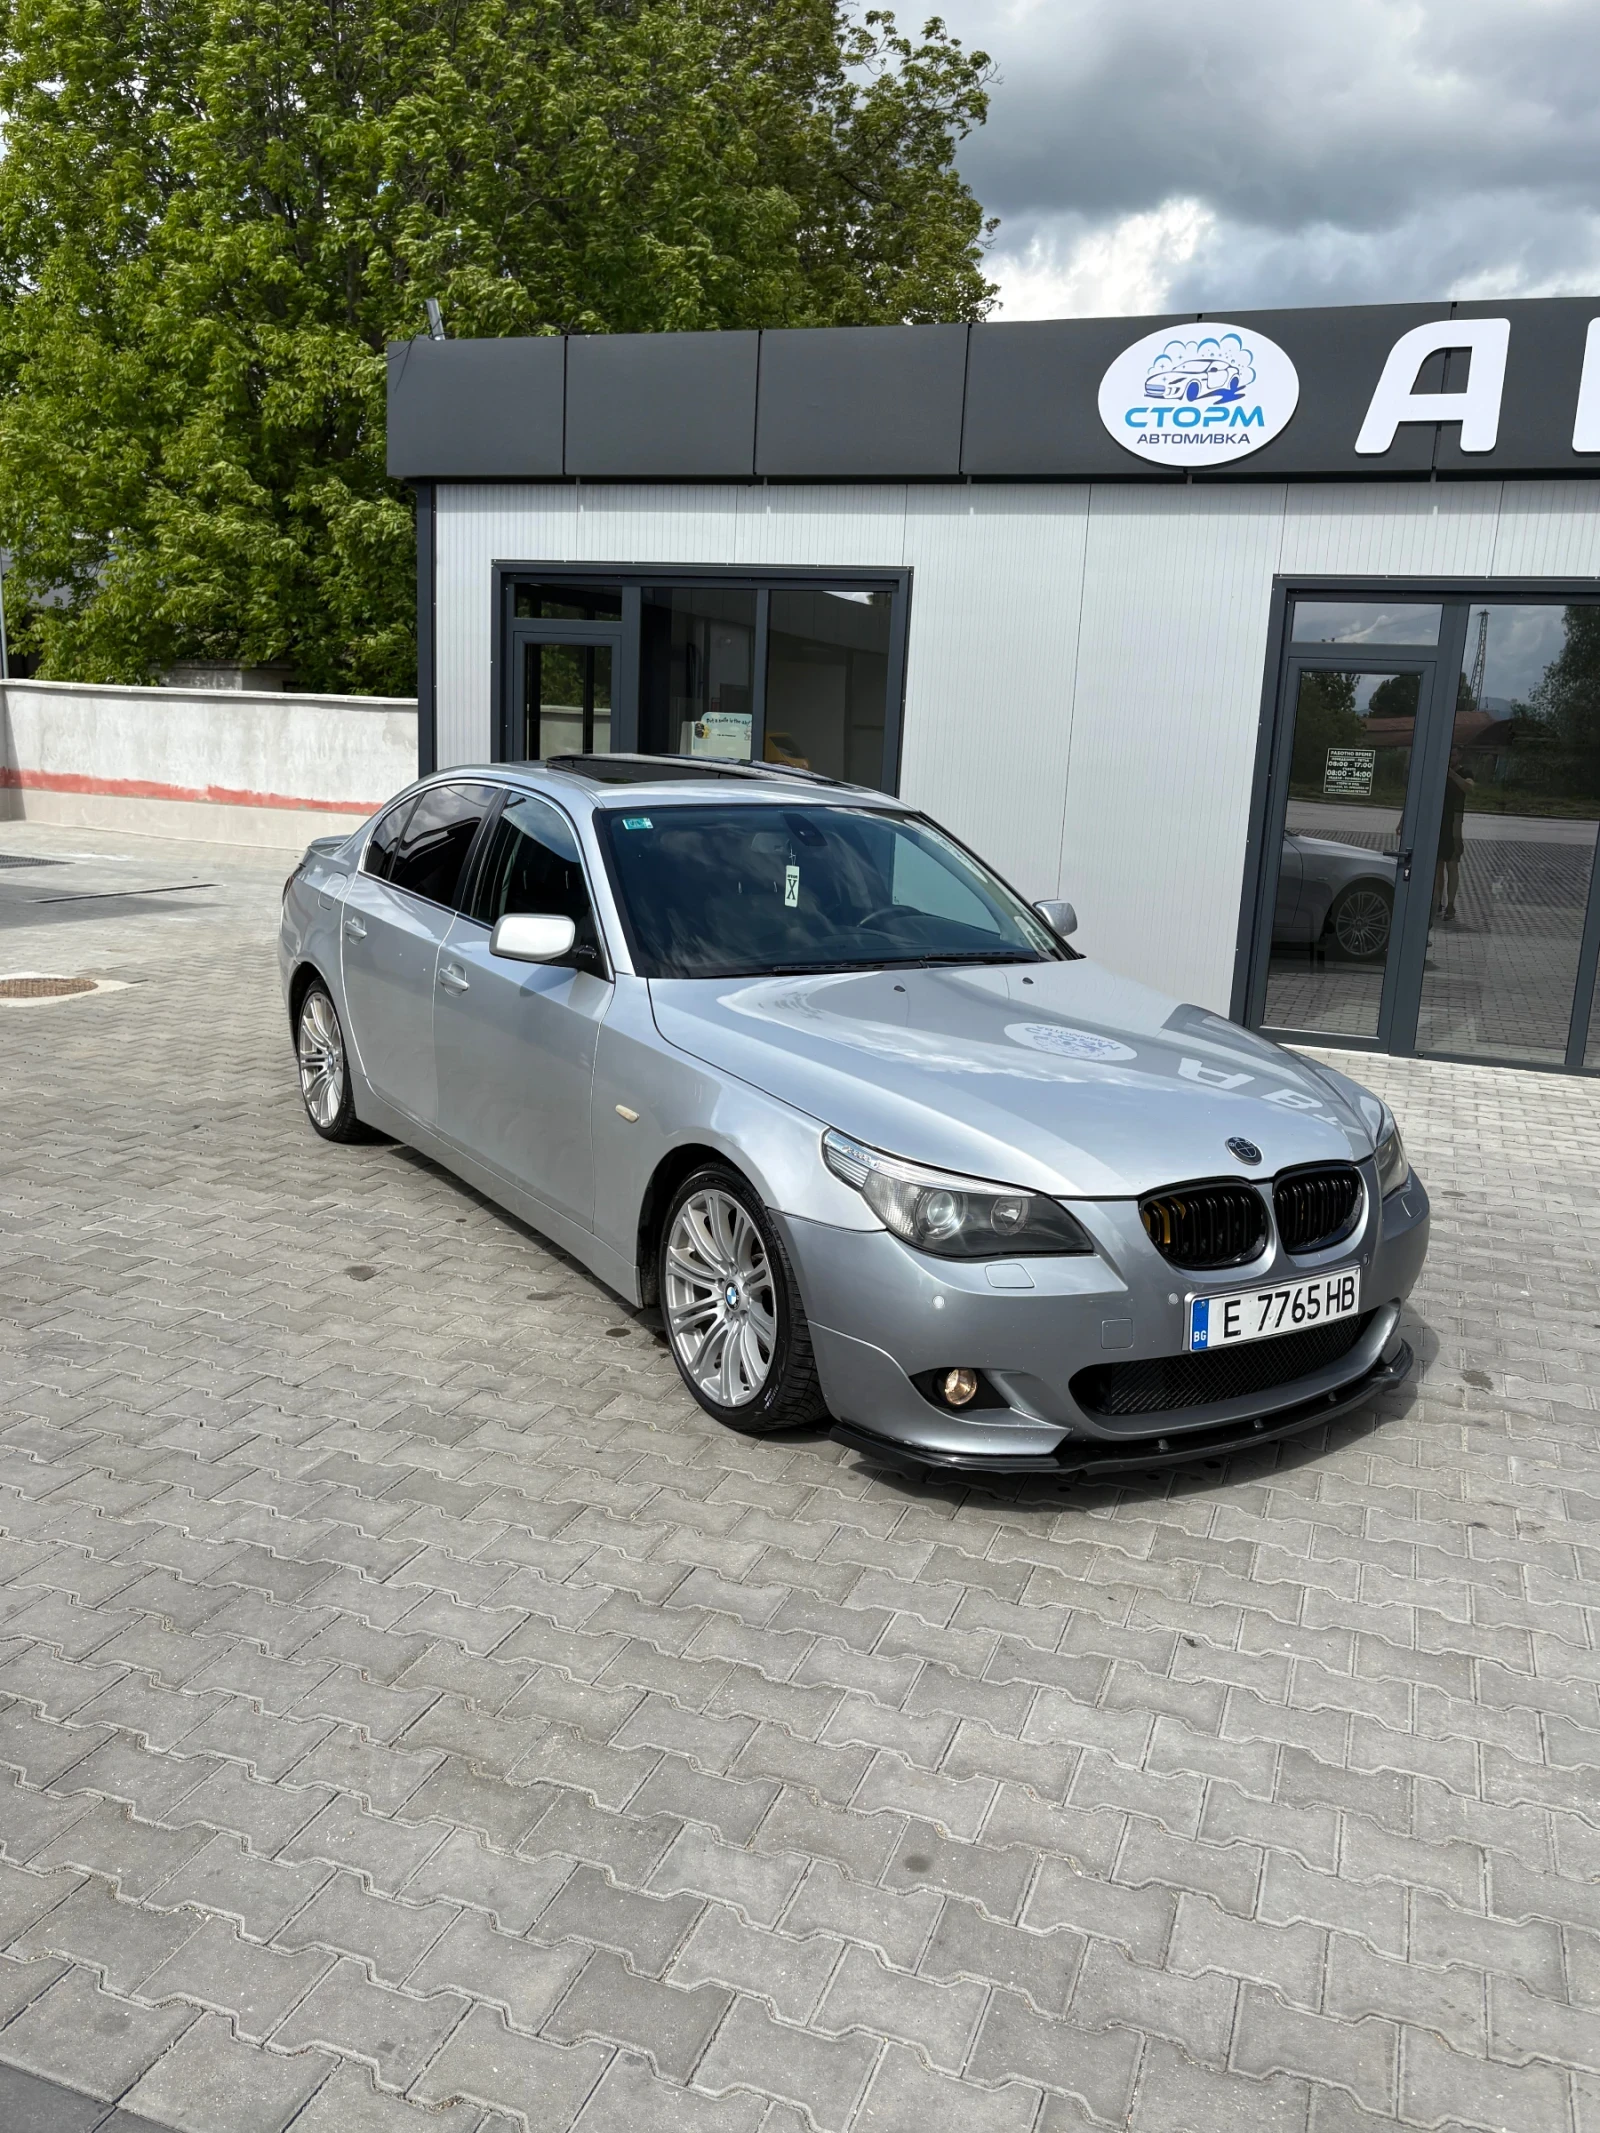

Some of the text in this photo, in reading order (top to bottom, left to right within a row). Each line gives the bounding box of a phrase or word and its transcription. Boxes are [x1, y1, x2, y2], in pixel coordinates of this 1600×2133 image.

[1124, 405, 1265, 428] СТОРМ
[1136, 433, 1251, 445] АВТОМИВКА
[787, 879, 797, 900] X
[1223, 1276, 1355, 1339] E 7765 HB
[1193, 1330, 1207, 1342] BG
